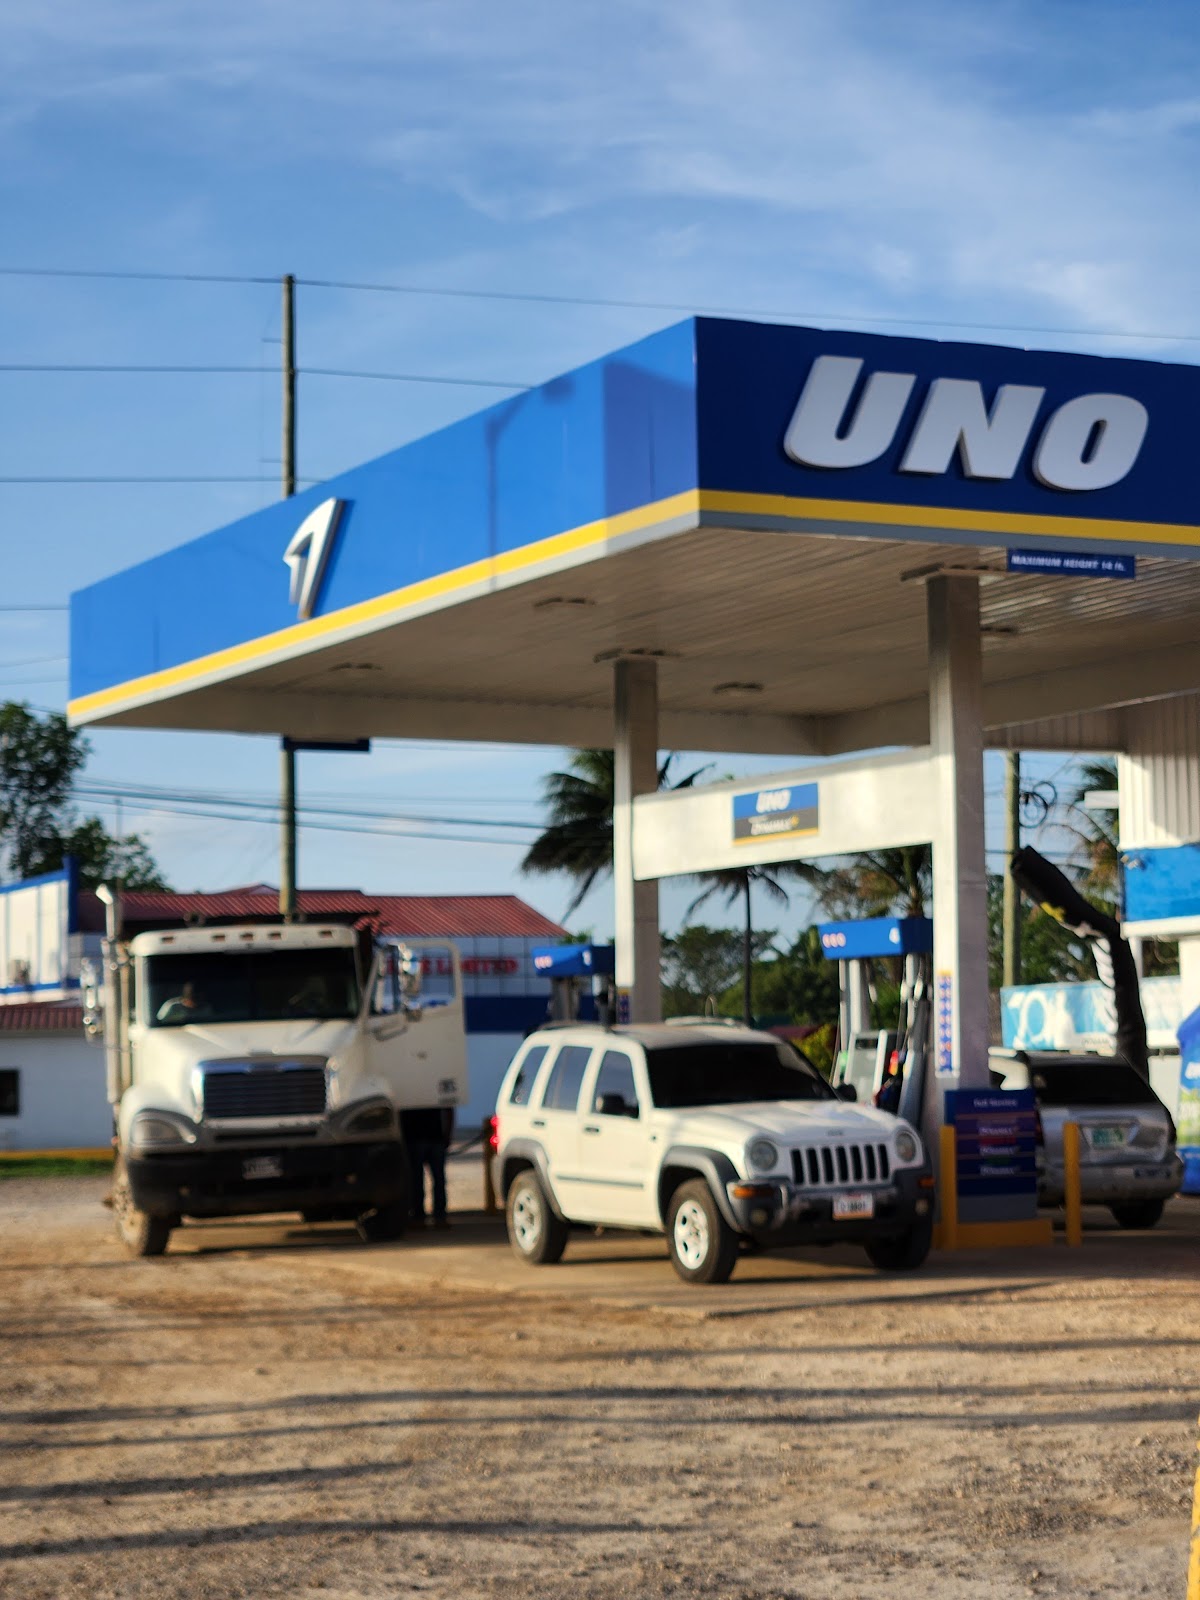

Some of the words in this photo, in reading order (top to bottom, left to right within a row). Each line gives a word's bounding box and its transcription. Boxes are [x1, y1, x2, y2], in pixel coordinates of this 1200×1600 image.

[784, 355, 1149, 491] UNO
[1010, 555, 1062, 568] MAXIMUM
[1063, 559, 1099, 569] HEIGHT
[756, 789, 791, 813] UNO
